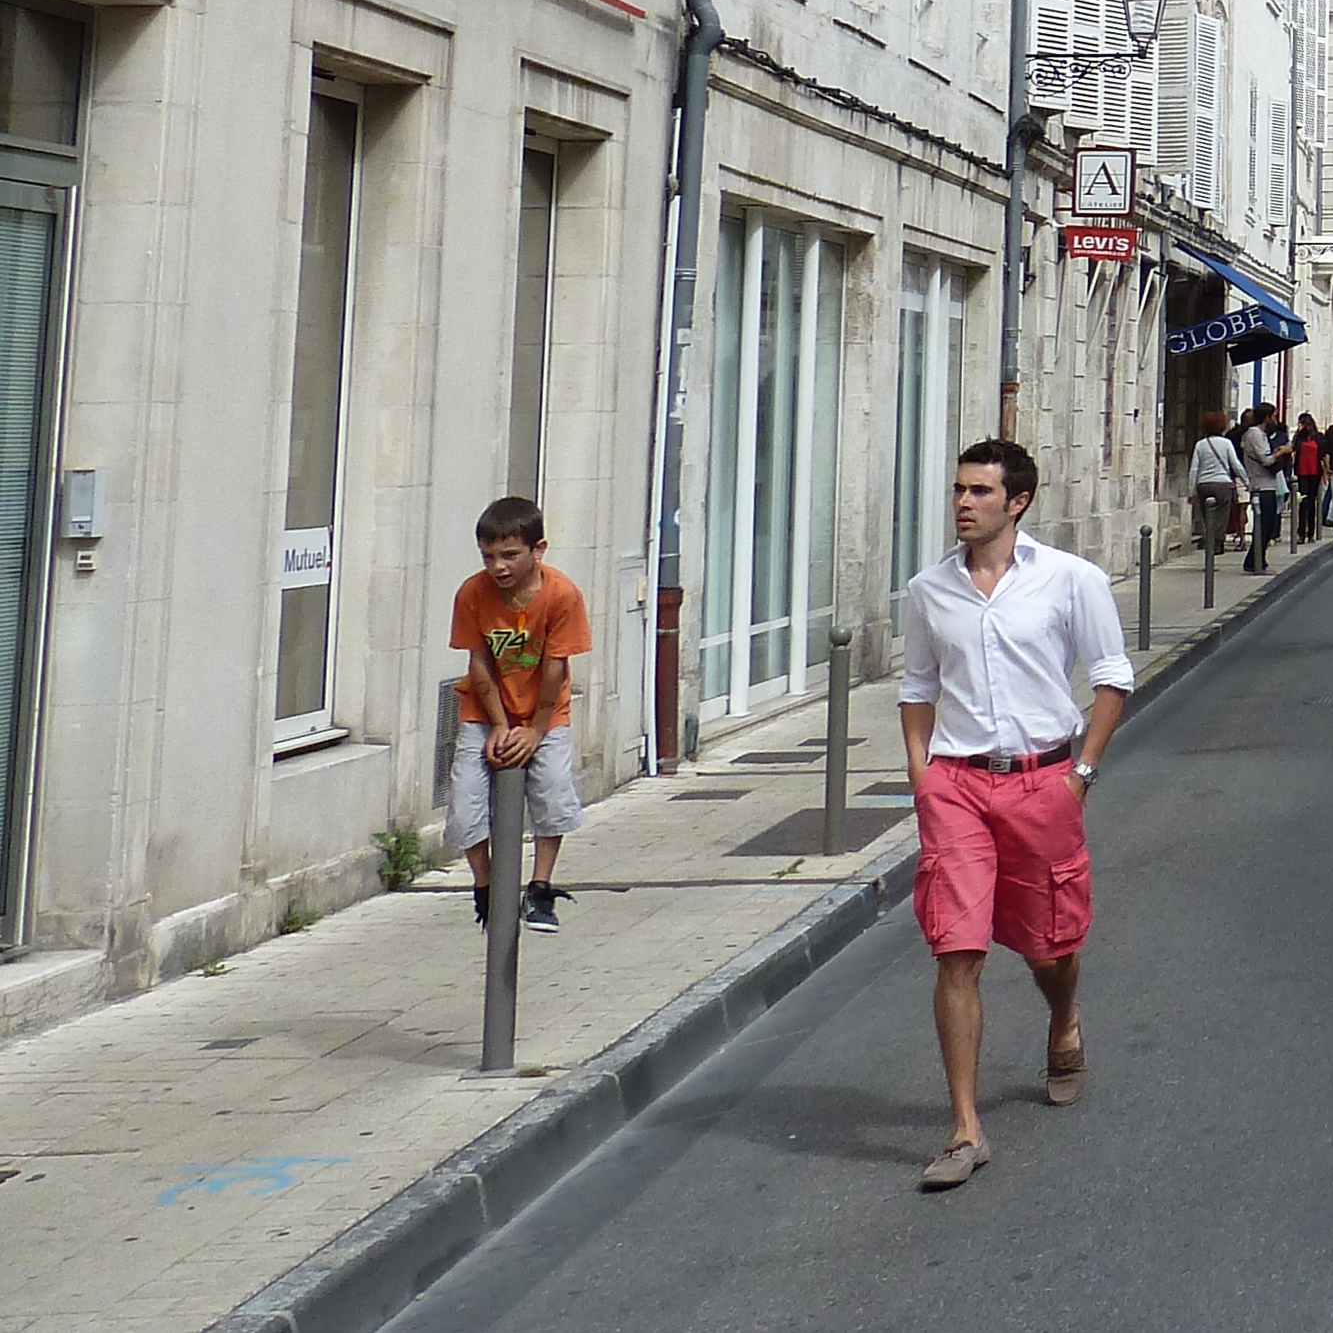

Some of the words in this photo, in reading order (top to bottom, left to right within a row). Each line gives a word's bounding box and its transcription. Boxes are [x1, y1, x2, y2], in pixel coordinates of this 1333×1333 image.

[1083, 160, 1122, 196] A
[1169, 305, 1265, 354] GLOBE
[284, 545, 327, 573] Mutuel
